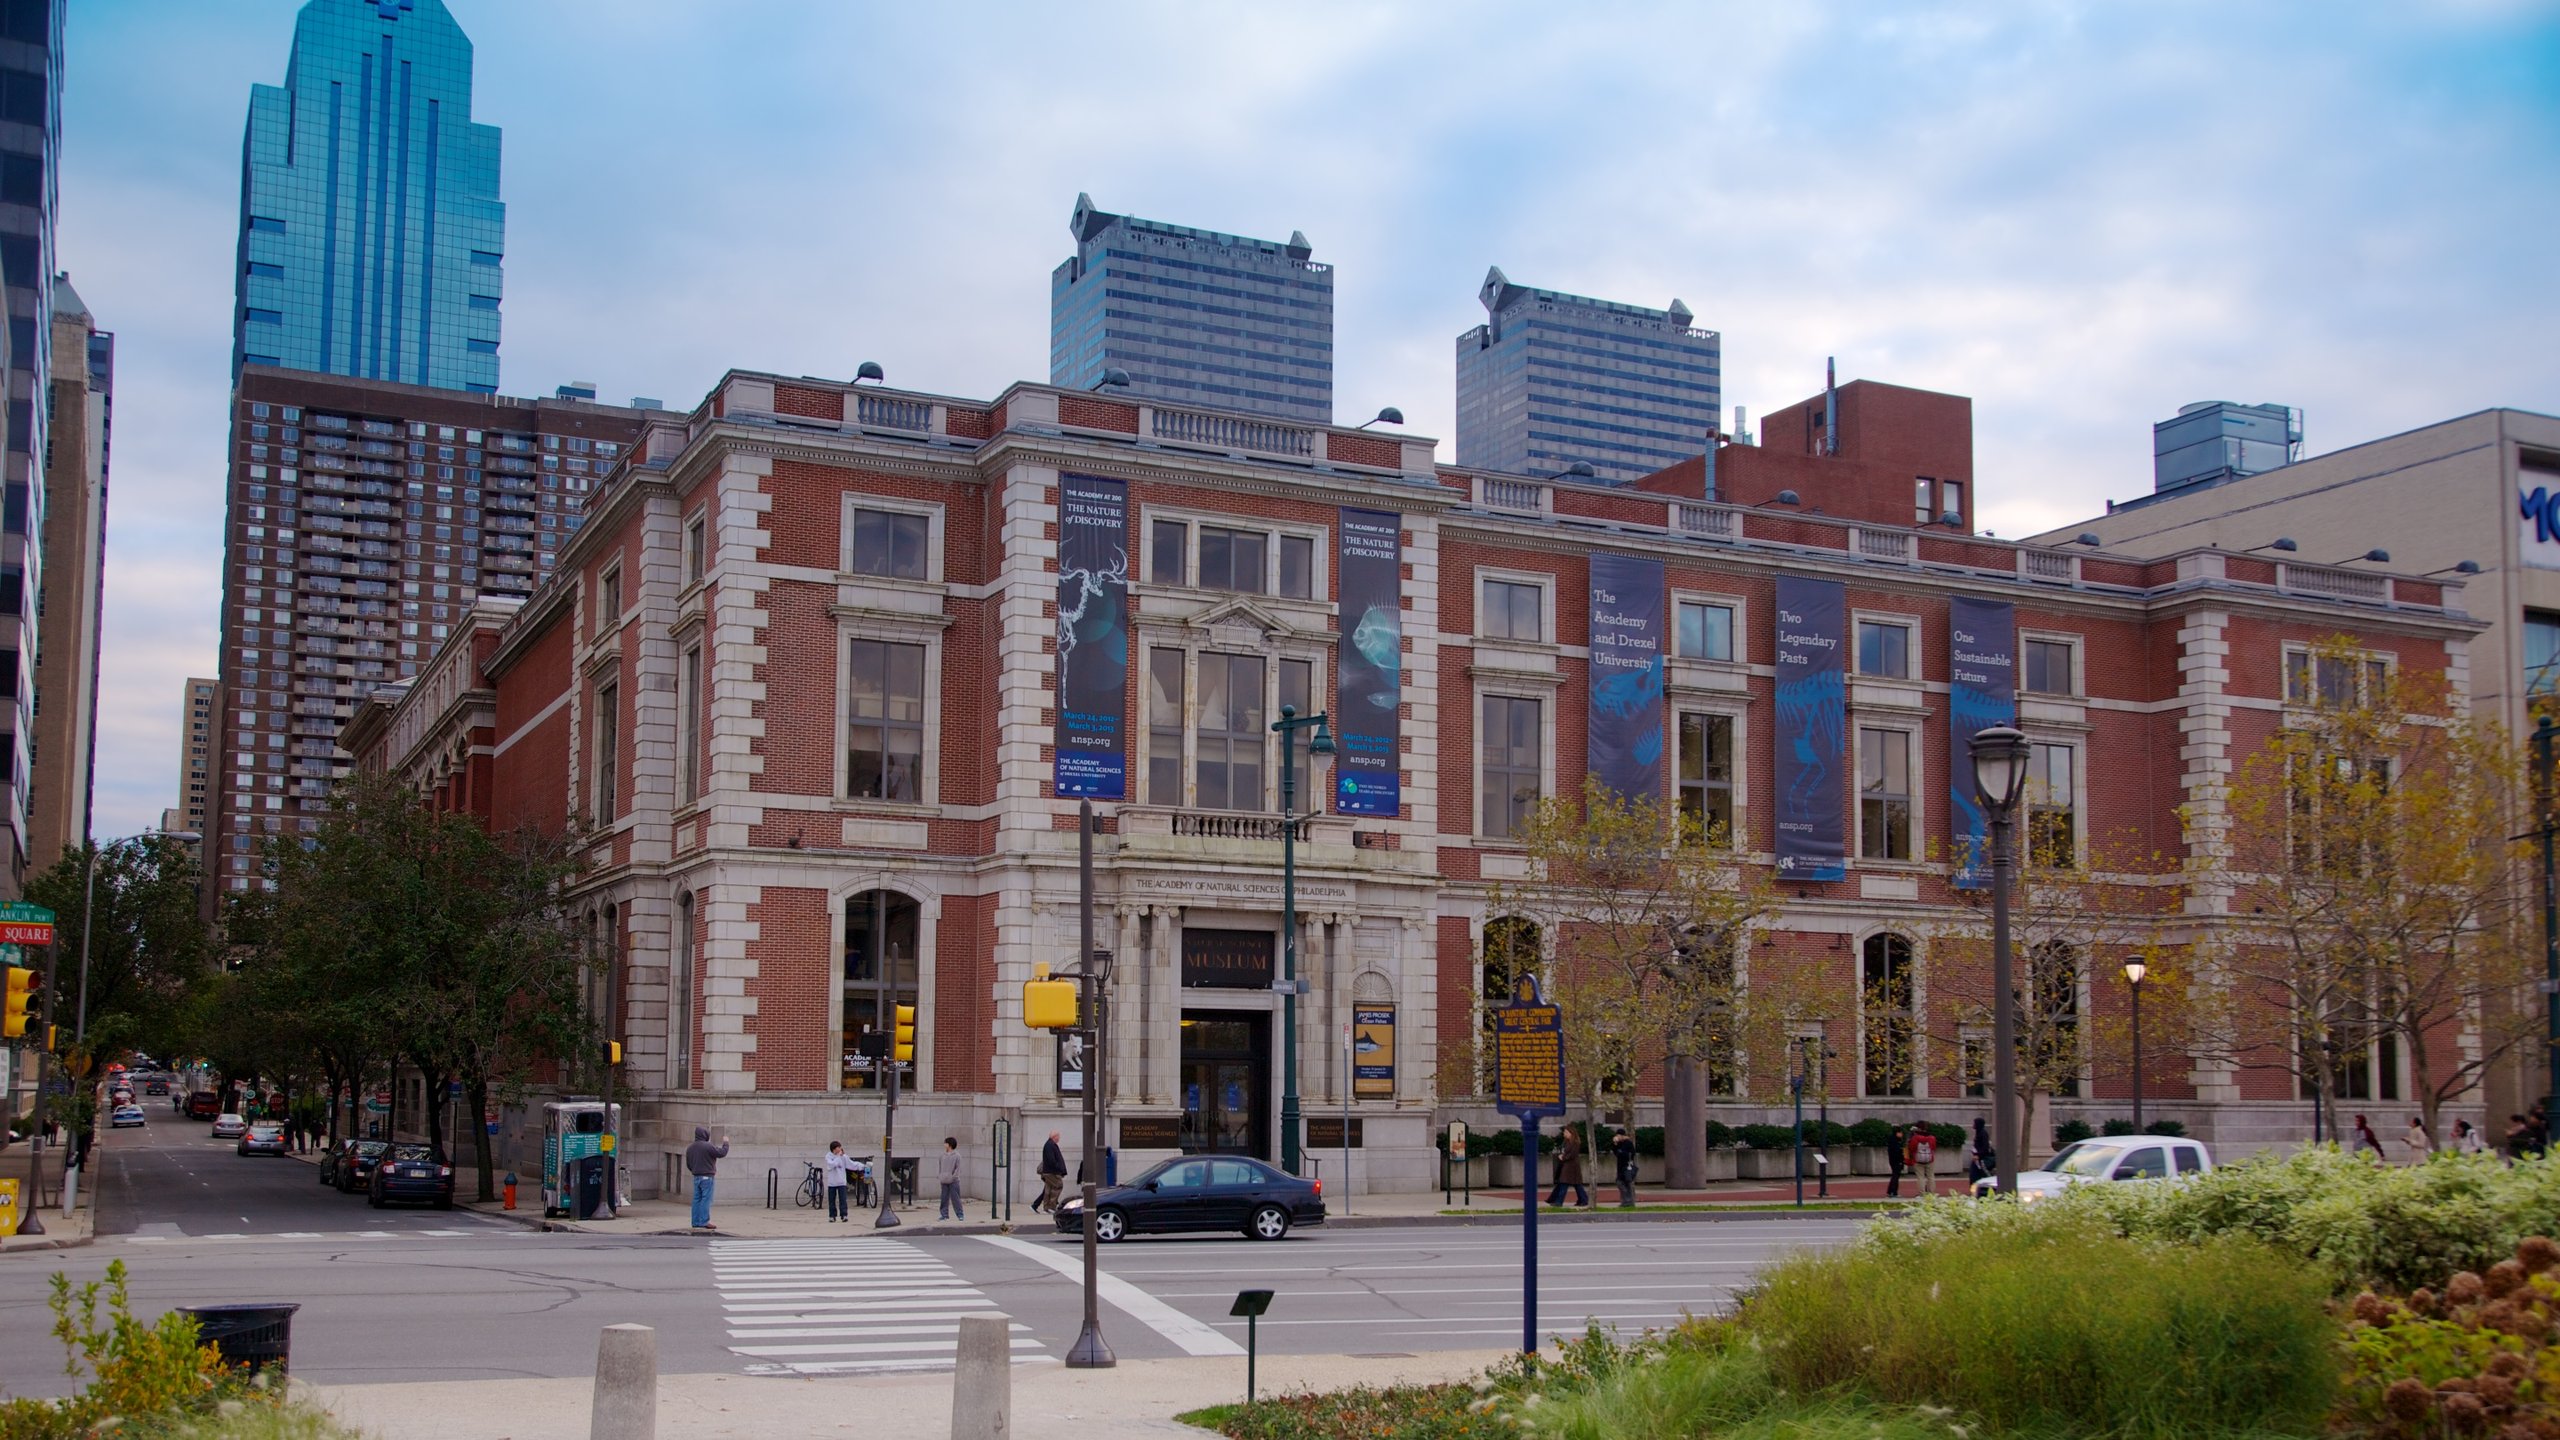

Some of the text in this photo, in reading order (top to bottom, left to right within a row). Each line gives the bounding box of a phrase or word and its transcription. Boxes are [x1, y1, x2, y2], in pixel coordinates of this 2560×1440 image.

[1078, 491, 1103, 499] ACADEMY
[1067, 503, 1121, 517] THE NATURE
[2520, 486, 2560, 545] M
[1065, 515, 1122, 528] of DISCOVERY
[1345, 535, 1394, 549] THE NATURE
[1343, 547, 1395, 560] of DISCOVERY
[1594, 589, 1616, 604] The
[1594, 610, 1647, 630] Academy
[1780, 610, 1802, 624] Two
[1594, 633, 1656, 649] and Drexel
[1780, 630, 1837, 650] Legendary
[1954, 630, 1975, 644] One
[1594, 652, 1654, 672] University
[1780, 650, 1808, 665] Pasts
[1954, 649, 2011, 666] Sustainable
[1954, 669, 1987, 683] Future
[1063, 712, 1086, 720] March
[1068, 721, 1090, 730] March
[1071, 736, 1111, 748] ansp.org
[1350, 756, 1386, 767] ansp.org
[1779, 822, 1813, 832] ansp.org
[1136, 879, 1153, 888] THE
[1154, 880, 1193, 890] ACADEMY
[1195, 881, 1206, 890] OF
[1206, 882, 1241, 892] NATURAL
[1243, 884, 1280, 894] SCIENCES
[1293, 887, 1346, 897] PHILADELPHIA
[35, 914, 51, 922] PKWY
[5, 927, 49, 942] SQUARE
[1187, 953, 1267, 970] MUSEUM
